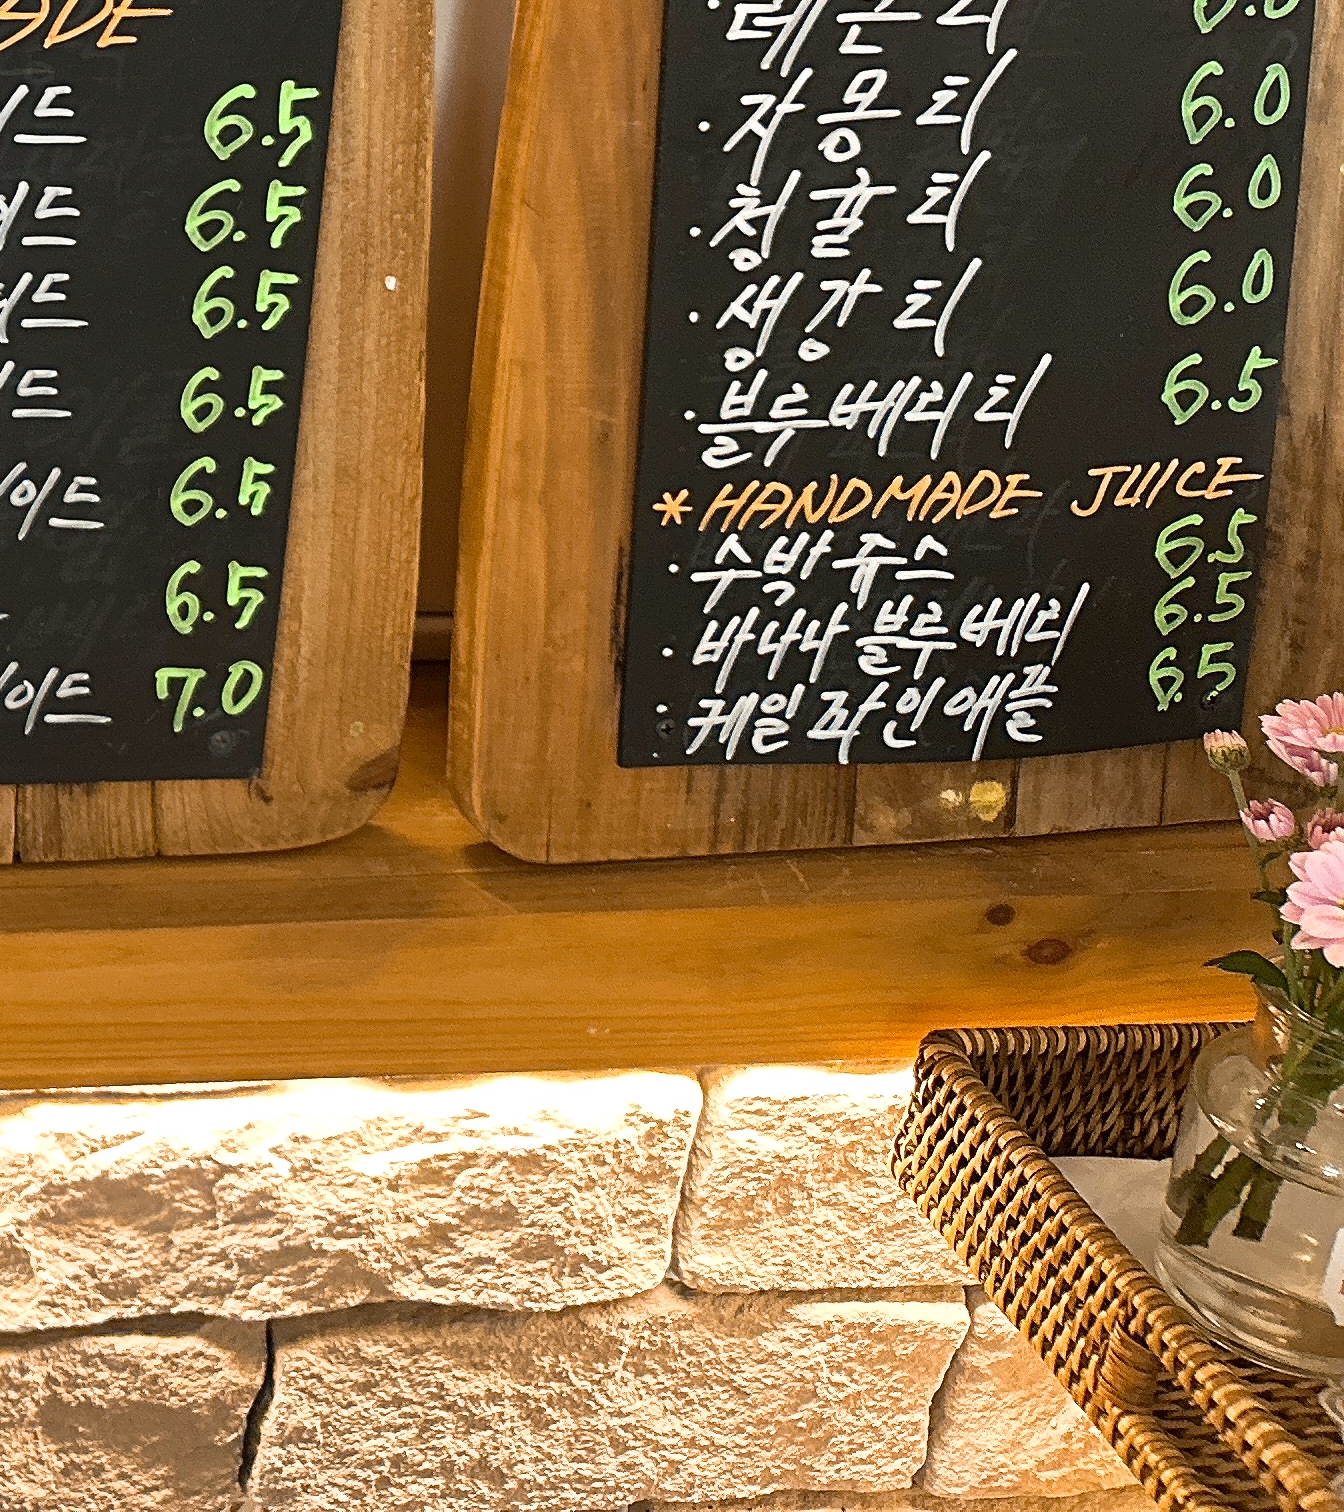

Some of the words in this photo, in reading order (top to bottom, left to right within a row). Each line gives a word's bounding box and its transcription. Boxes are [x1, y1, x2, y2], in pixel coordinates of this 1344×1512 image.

[204, 80, 319, 167] 6.5
[1181, 61, 1289, 144] 6.0
[185, 179, 306, 252] 6.5
[1173, 154, 1280, 232] 6.0
[192, 266, 298, 339] 6.5
[1169, 249, 1273, 325] 6.0
[181, 366, 283, 433] 6.5
[1161, 346, 1278, 425] 6.5
[170, 457, 274, 526] 6.5
[698, 470, 1043, 533] HANDMADE
[1071, 457, 1264, 519] JUICE
[1155, 508, 1257, 579] 6.5
[166, 560, 266, 634] 6.5
[1154, 572, 1252, 635] 6.5
[155, 661, 262, 732] 7.0
[1149, 642, 1235, 711] 6.5
